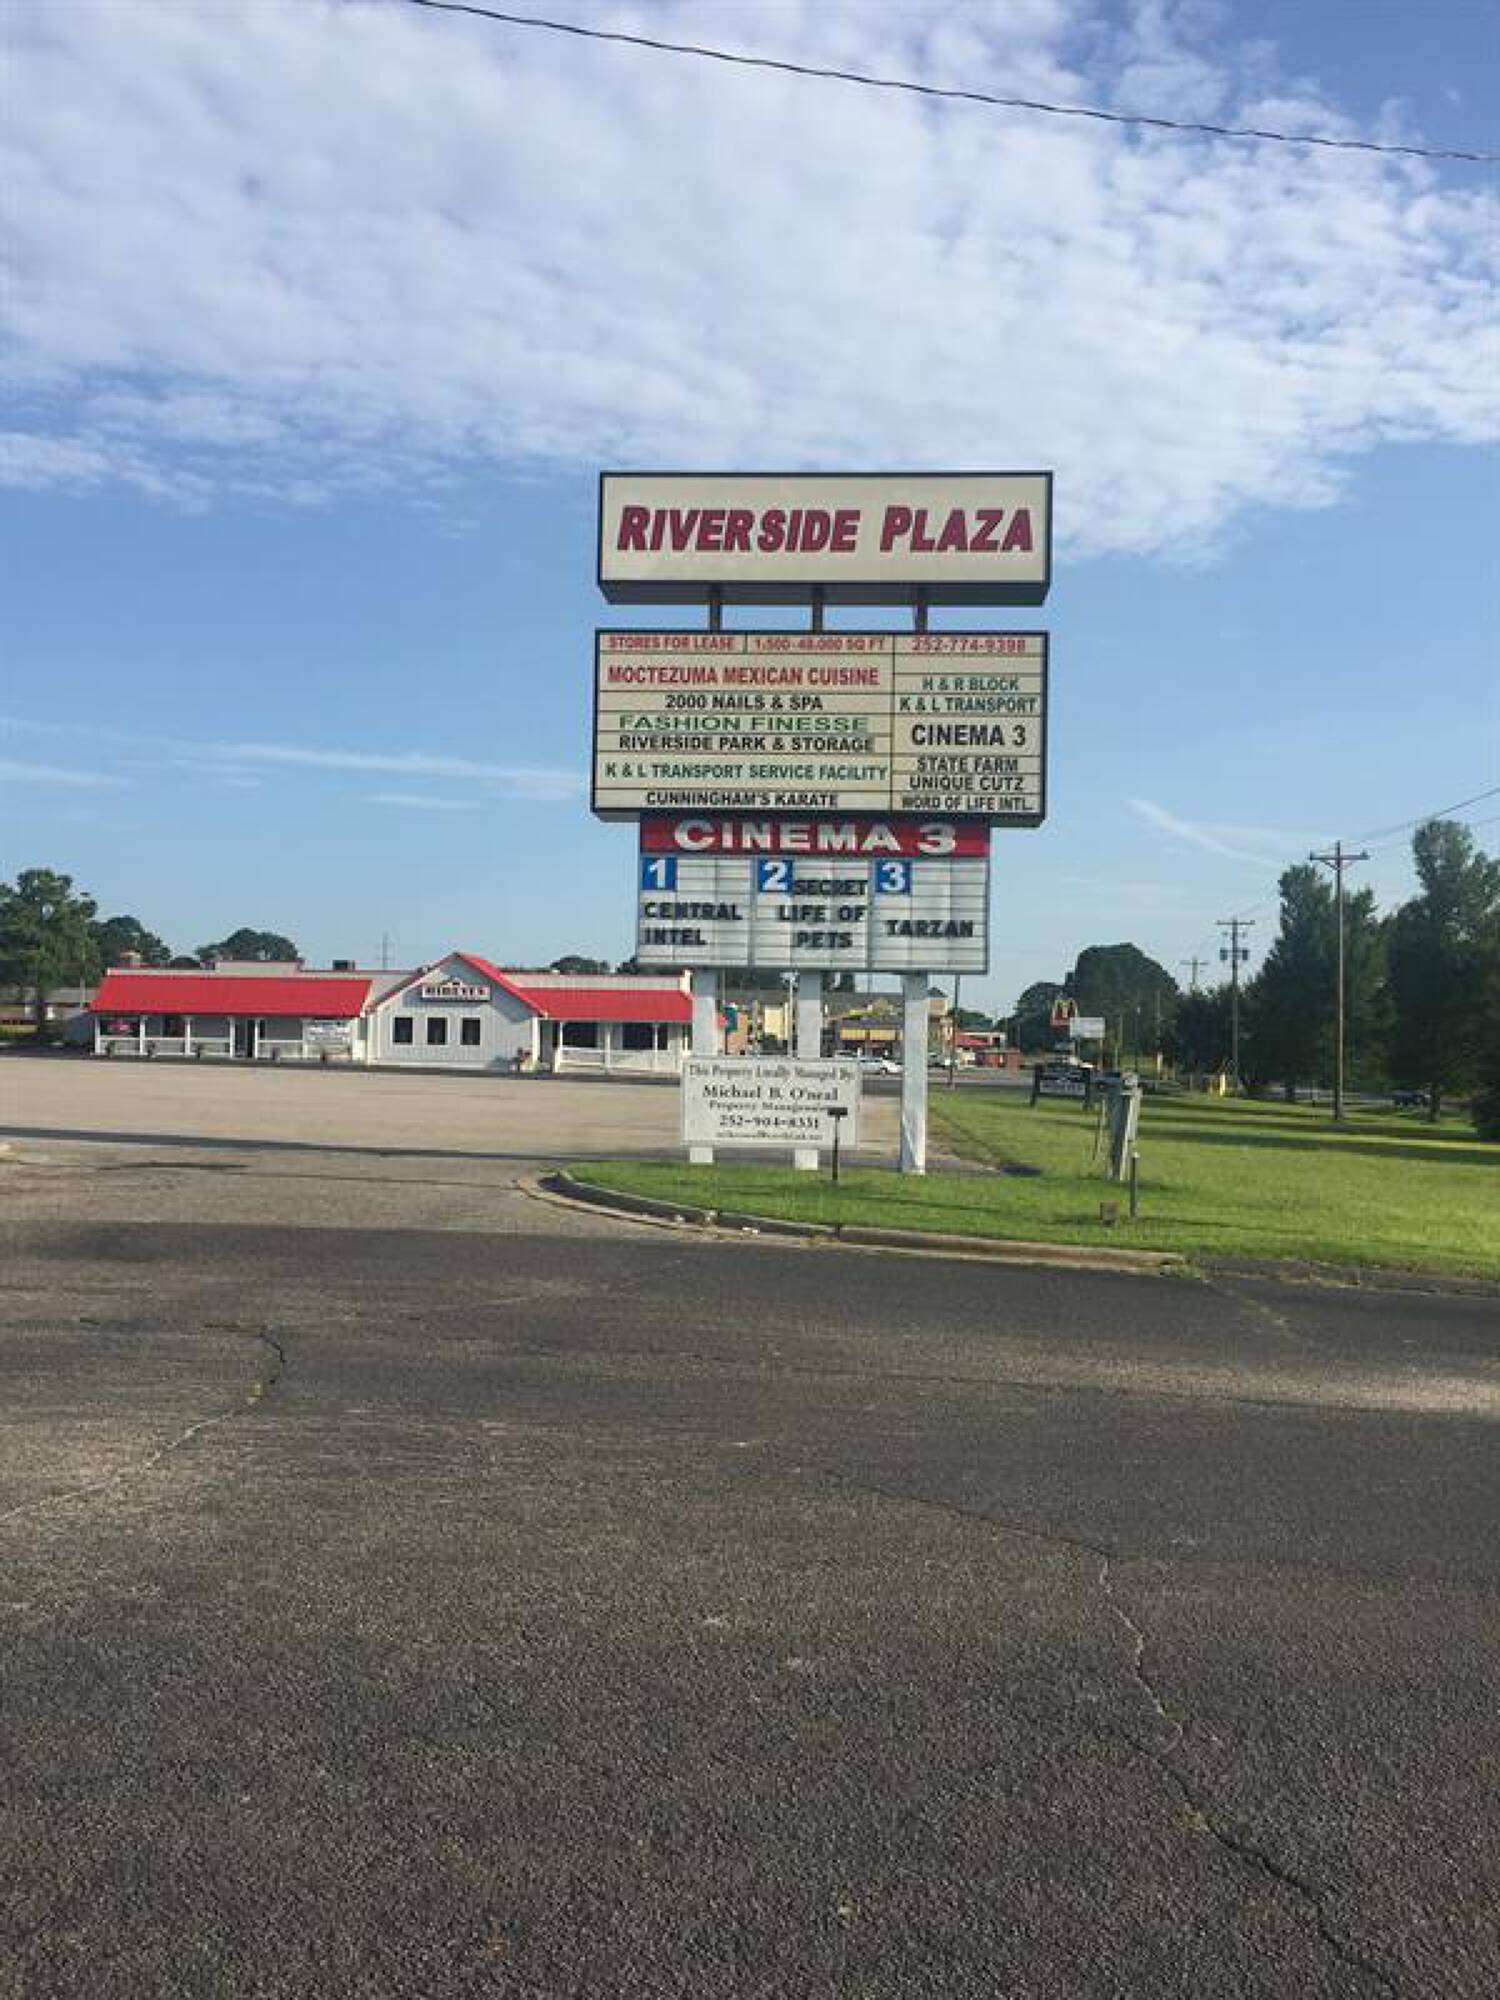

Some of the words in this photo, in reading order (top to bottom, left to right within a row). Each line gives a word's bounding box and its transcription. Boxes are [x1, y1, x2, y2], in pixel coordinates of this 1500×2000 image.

[617, 505, 861, 553] RIVERSIDE
[880, 505, 1034, 553] PLAZA
[608, 635, 661, 649] STORES
[664, 635, 690, 649] FOR
[694, 635, 735, 650] LEASE
[846, 637, 866, 651] SQ
[868, 637, 884, 651] FT
[608, 666, 718, 684] MOCTEZUMA
[723, 667, 802, 685] MEXICAN
[808, 667, 880, 686] CUISINE
[922, 677, 933, 691] H
[938, 677, 949, 691] &
[955, 677, 965, 691] R
[970, 677, 1020, 691] BLOCK
[665, 694, 705, 709] 2000
[712, 695, 766, 710] NAILS
[771, 696, 783, 710] &
[789, 696, 824, 711] SPA
[900, 697, 911, 712] K
[915, 698, 926, 712] &
[932, 698, 941, 712] L
[945, 698, 1037, 713] TRANSPORT
[619, 715, 742, 731] FASHION
[751, 716, 869, 732] FINESSE
[619, 735, 713, 751] RIVERSIDE
[719, 736, 766, 751] PARK
[772, 736, 784, 751] &
[791, 736, 876, 751] STORAGE
[911, 724, 1005, 746] CINEMA
[1012, 724, 1026, 746] 3
[605, 762, 617, 778] K
[622, 762, 635, 778] &
[638, 763, 647, 778] L
[652, 763, 745, 779] TRANSPORT
[750, 764, 814, 780] SERVICE
[819, 765, 888, 781] FACILITY
[917, 756, 965, 772] STATE
[975, 757, 1018, 773] FARM
[909, 776, 973, 791] UNIQUE
[980, 777, 1024, 791] CUTZ
[646, 791, 770, 806] CUNNINGHAM'S
[774, 792, 838, 807] KARATE
[902, 796, 940, 809] WORD
[944, 796, 961, 809] OF
[967, 796, 995, 810] LIFE
[674, 819, 901, 851] CINEMA
[918, 821, 957, 853] 3
[648, 859, 666, 889] 1
[762, 861, 789, 891] 2
[881, 862, 907, 891] 3
[793, 879, 868, 896] SECRET
[644, 902, 743, 921] CENTRAL
[779, 905, 827, 922] LIFE
[837, 905, 867, 922] OF
[644, 928, 707, 946] INTEL
[884, 919, 974, 938] TARZAN
[797, 932, 852, 948] PETS
[703, 1084, 761, 1098] Michael
[769, 1086, 784, 1100] B.
